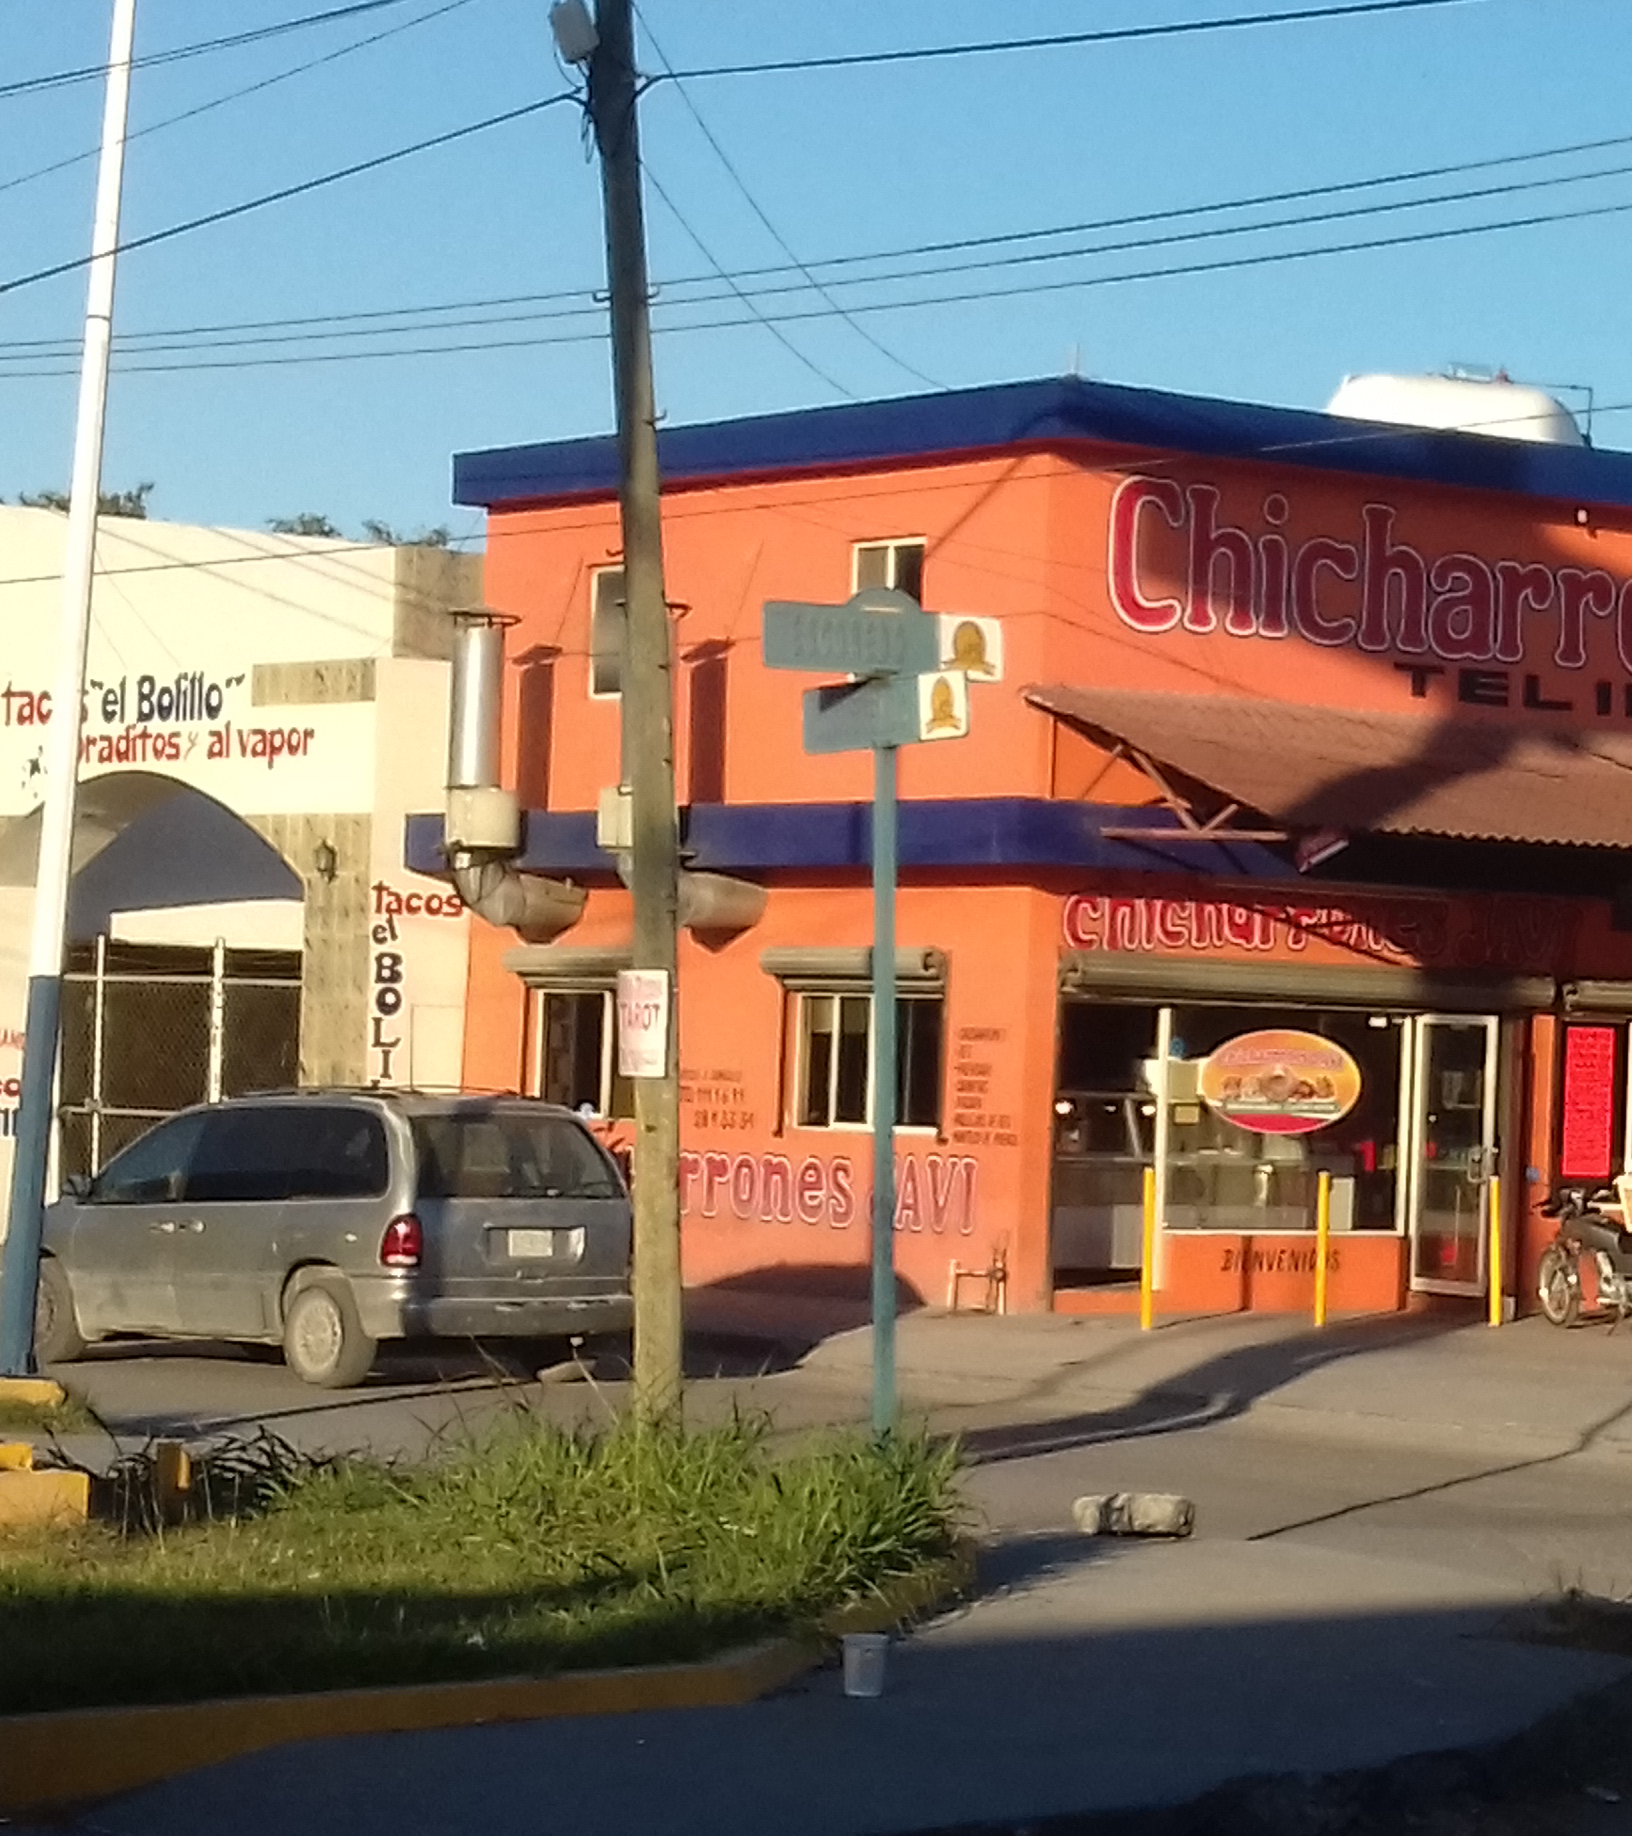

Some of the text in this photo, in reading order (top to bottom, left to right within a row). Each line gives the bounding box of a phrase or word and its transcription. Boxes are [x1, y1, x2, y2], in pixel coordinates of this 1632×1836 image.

[1, 681, 89, 726] tac
[1393, 661, 1573, 712] TEL
[207, 720, 231, 760] al
[237, 727, 315, 770] vapor
[371, 880, 464, 918] tacos
[372, 913, 398, 945] el
[371, 952, 403, 1090] BOLI
[868, 1152, 979, 1236] AVI
